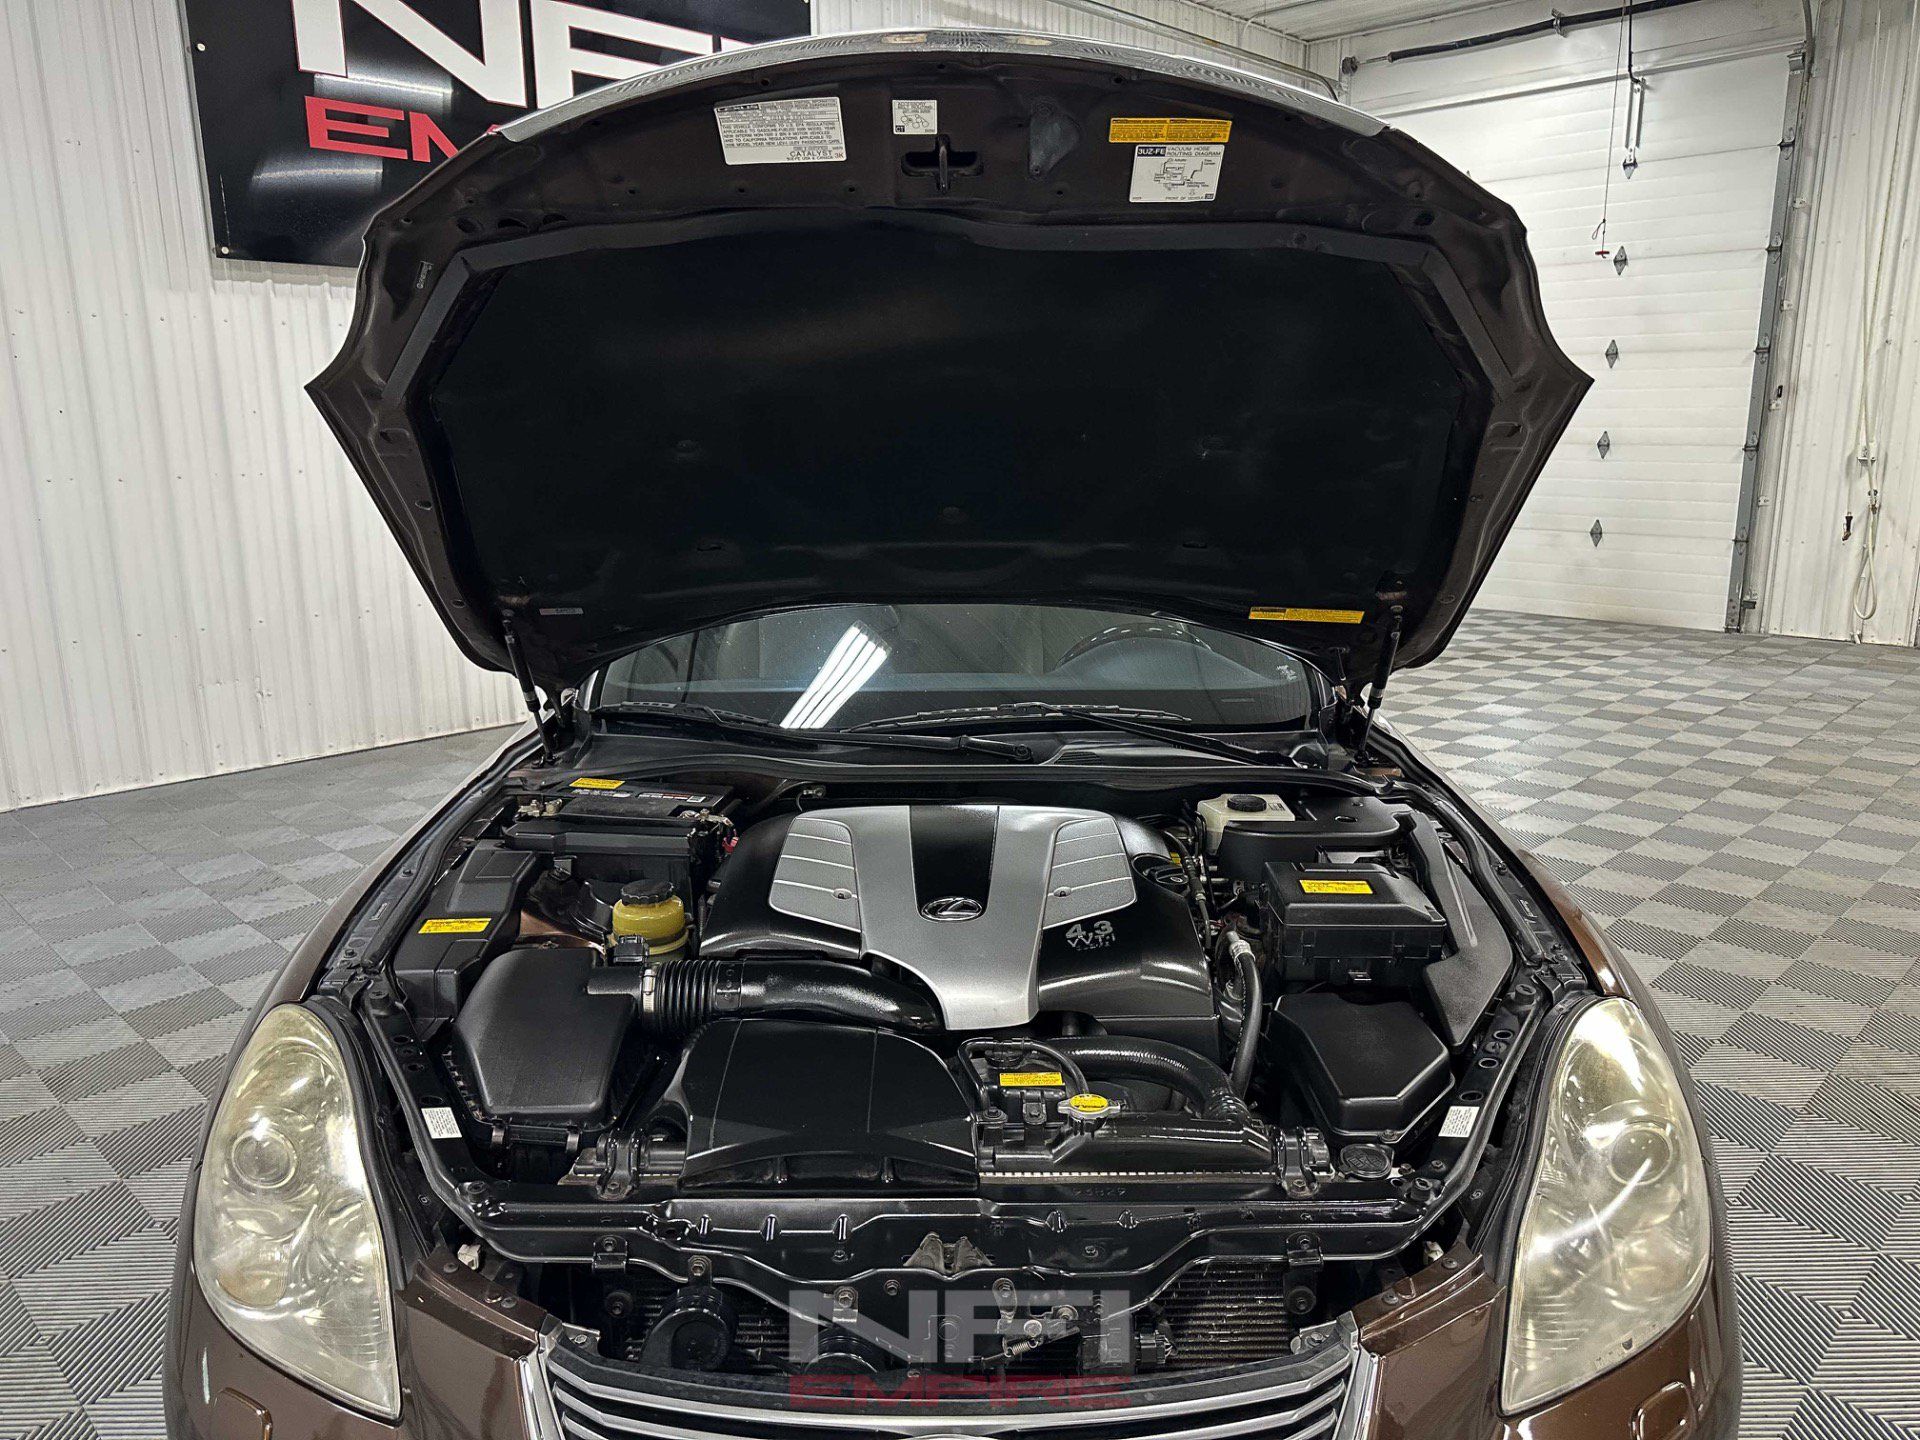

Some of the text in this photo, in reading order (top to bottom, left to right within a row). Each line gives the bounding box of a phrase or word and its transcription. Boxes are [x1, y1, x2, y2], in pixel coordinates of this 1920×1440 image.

[290, 0, 756, 111] NF
[1137, 147, 1166, 156] 3UZ-FE
[1065, 920, 1113, 939] 4.3
